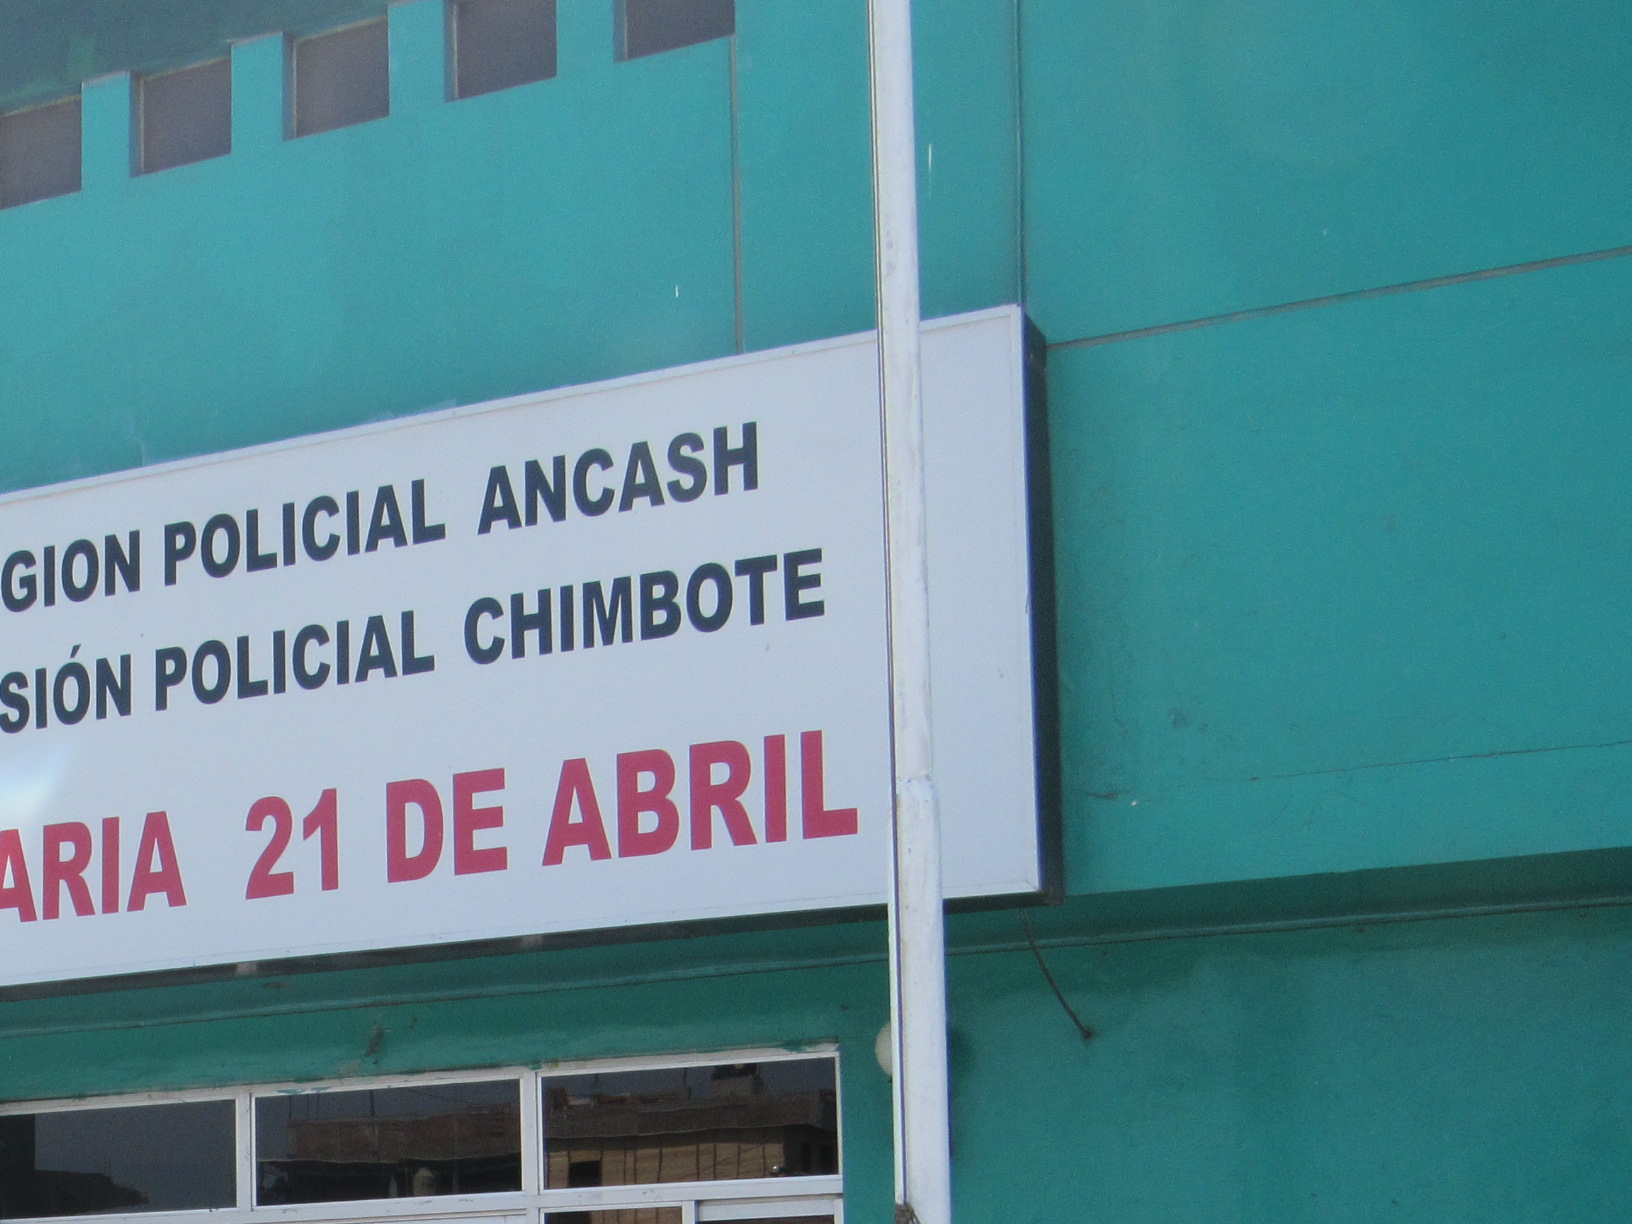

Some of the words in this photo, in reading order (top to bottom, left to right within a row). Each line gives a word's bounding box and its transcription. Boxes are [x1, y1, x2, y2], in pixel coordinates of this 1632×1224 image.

[166, 479, 445, 584] POLICIAL
[479, 422, 760, 537] ANCASH
[155, 611, 436, 712] POLICIAL
[464, 548, 826, 667] CHIMBOTE
[246, 789, 340, 900] 21
[387, 769, 509, 884] DE
[542, 730, 859, 866] ABRIL
